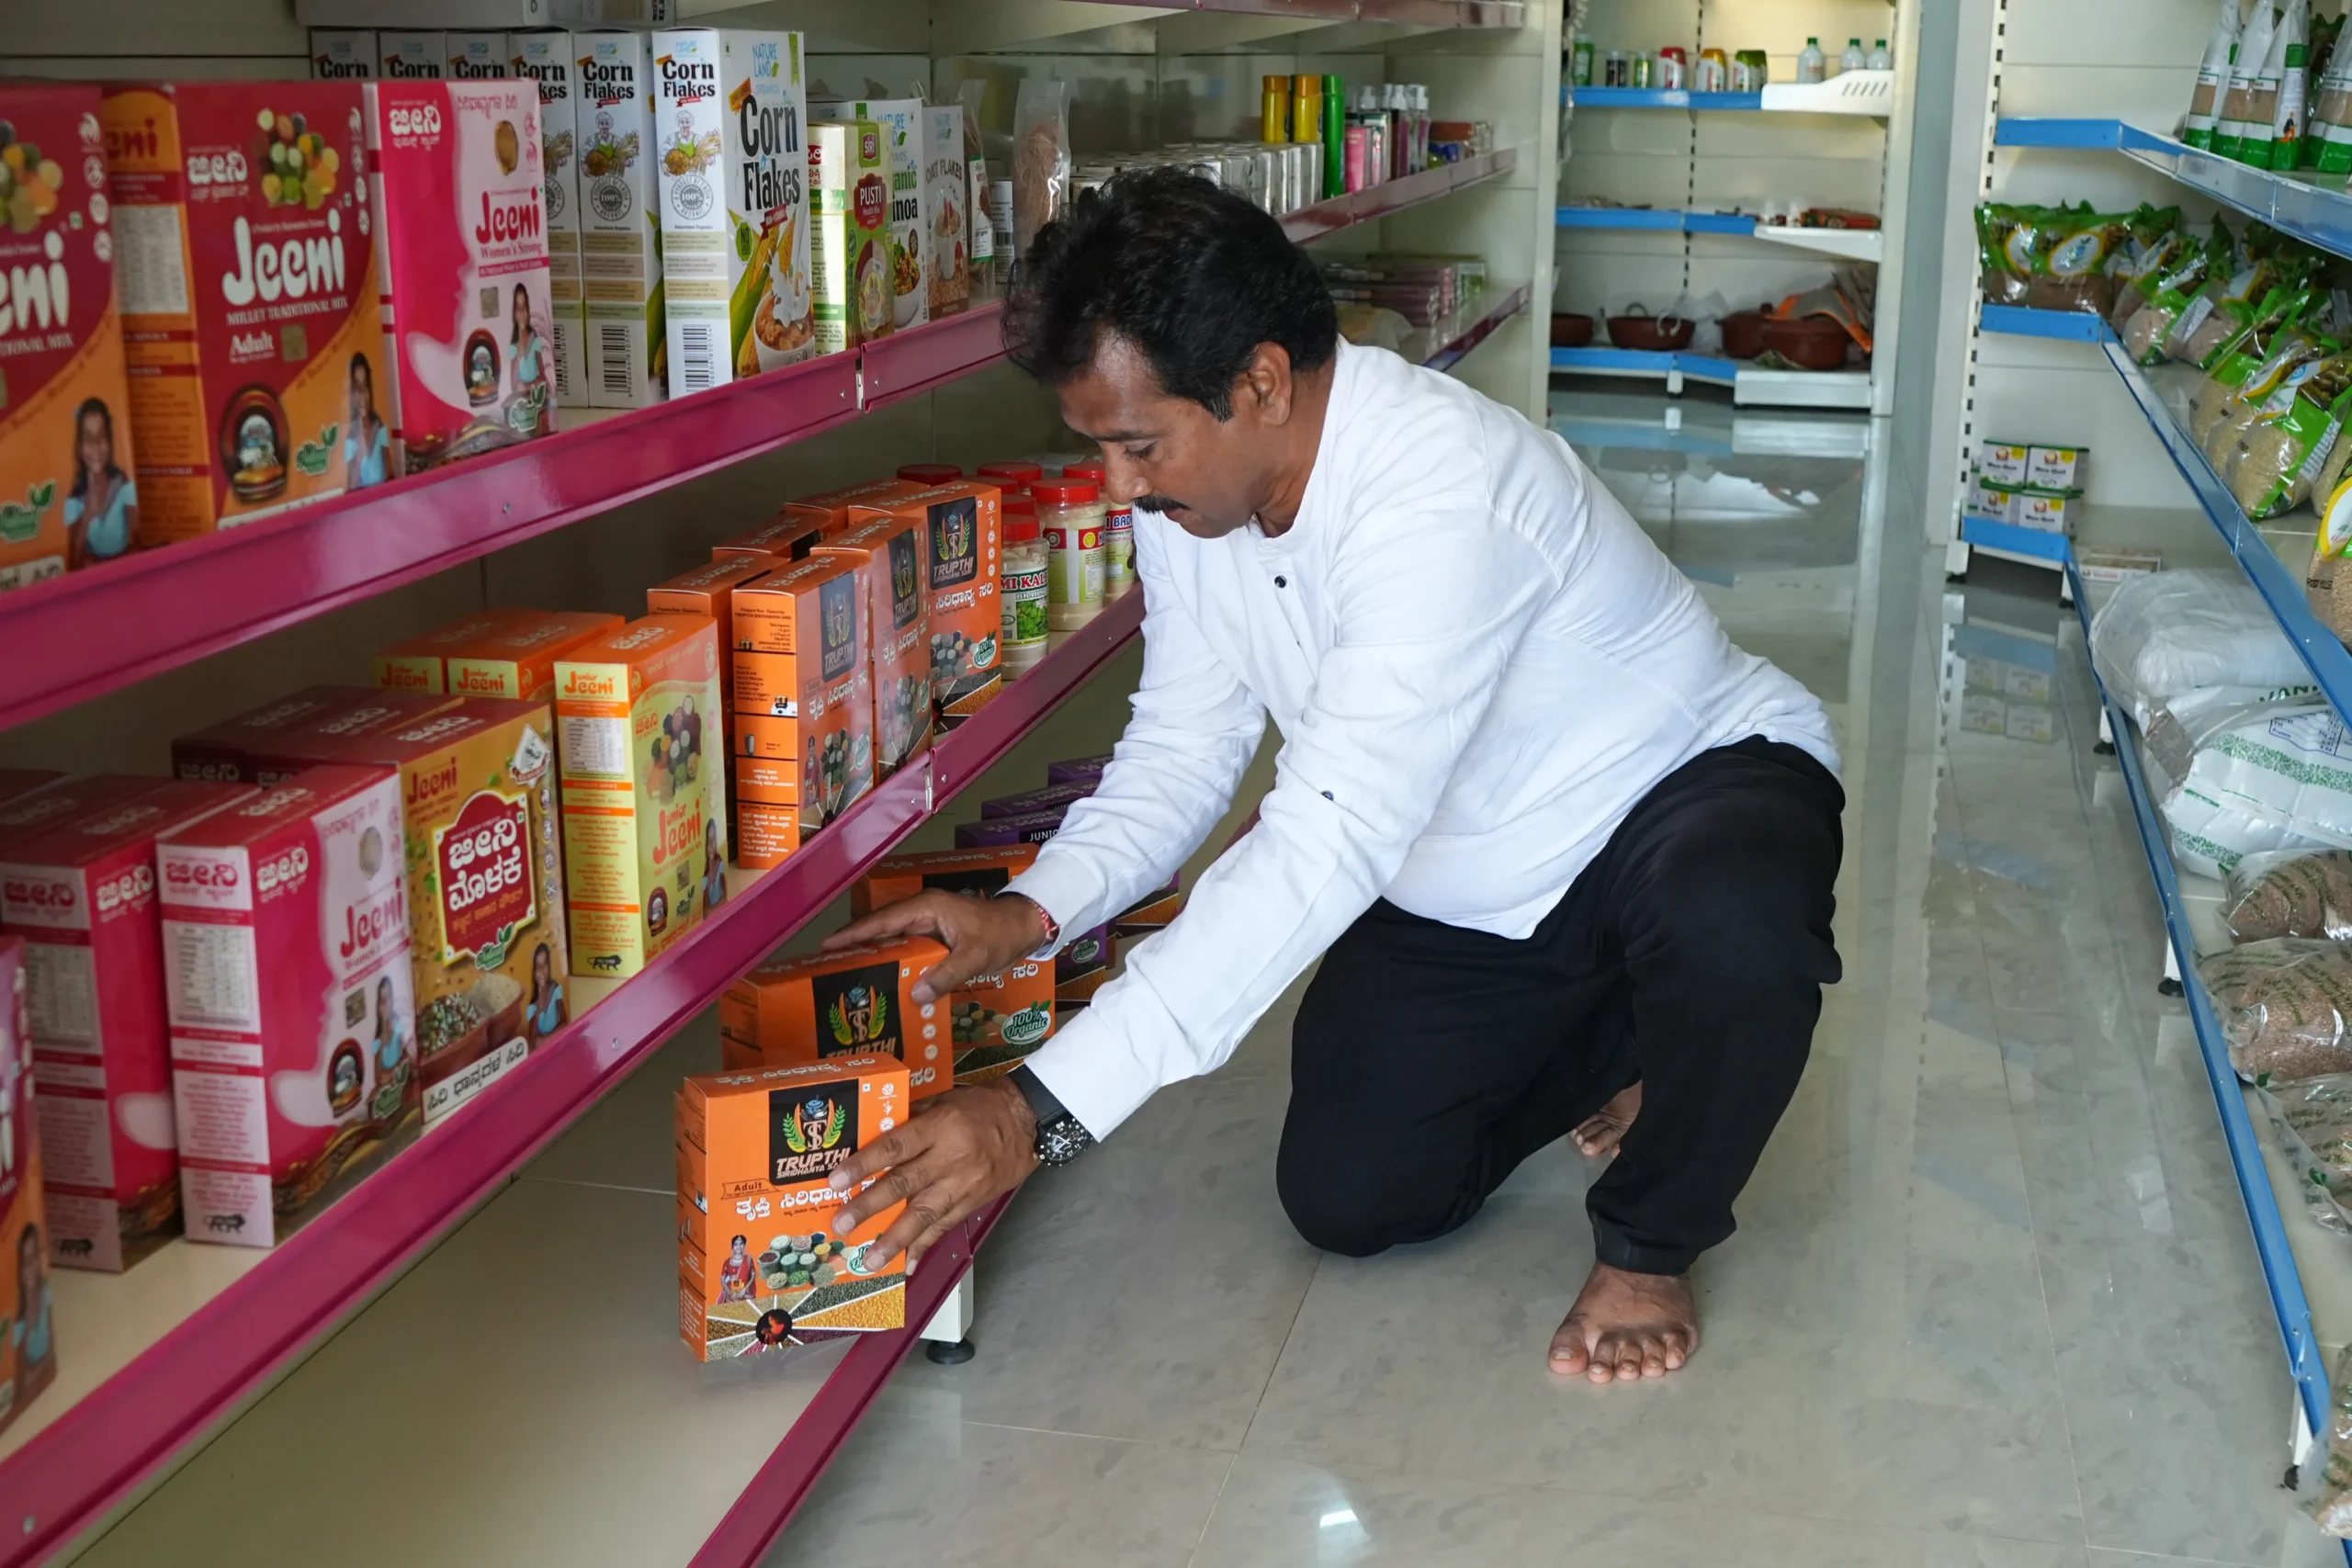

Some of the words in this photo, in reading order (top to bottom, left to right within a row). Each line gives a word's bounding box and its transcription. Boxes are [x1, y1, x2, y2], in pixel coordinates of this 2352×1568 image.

[752, 42, 778, 60] NATURE
[321, 60, 369, 79] Corn
[390, 60, 440, 79] Corn
[455, 60, 505, 79] Corn
[514, 61, 565, 81] Corn
[582, 61, 634, 82] Corn
[662, 59, 714, 80] Corn
[753, 60, 773, 78] LAND
[539, 83, 567, 99] kes
[584, 82, 635, 99] Flakes
[662, 81, 716, 98] Flakes
[389, 104, 442, 135] ಜೀನಿ
[741, 95, 798, 158] Corn
[107, 117, 158, 159] eni
[187, 150, 248, 185] ಜೀನಿ
[893, 164, 917, 191] anic
[926, 161, 939, 183] OAT
[939, 158, 962, 181] FLAKES
[681, 192, 704, 201] 100%
[743, 160, 800, 212] Flakes
[860, 186, 882, 206] PUSTI
[601, 193, 622, 203] 100%
[892, 194, 918, 221] inoa
[475, 186, 540, 244] Jeeni
[741, 228, 750, 244] NO
[222, 208, 345, 306] Jeeni
[481, 244, 517, 260] Women's
[518, 242, 543, 255] Strong
[0, 230, 70, 336] eni
[226, 309, 266, 327] MILLET
[267, 299, 331, 321] TRADITIONAL
[331, 296, 348, 309] MIX
[229, 329, 275, 355] Adult
[1113, 514, 1133, 529] BAD
[933, 556, 974, 579] TRUPTHI
[1021, 573, 1046, 589] KAL
[935, 587, 976, 610] ಸಿರಿಧಾನ್ಯ
[978, 582, 994, 598] ಸರಿ
[824, 641, 854, 667] TRUPTHI
[380, 664, 429, 687] Jeeni
[457, 667, 505, 691] Jeeni
[564, 671, 615, 694] Jeeni
[407, 755, 458, 806] Jeeni
[652, 797, 702, 864] Jeeni
[1029, 829, 1058, 842] JUNIO
[448, 818, 517, 870] ಜೀನಿ
[165, 861, 239, 887] ಜೀನಿ
[255, 846, 310, 892] ಜೀನಿ
[447, 845, 523, 911] ಮೊಳಕೆ
[96, 865, 154, 911] ಜೀನಿ
[340, 875, 404, 958] Jeeni
[1012, 963, 1039, 979] ಸರಿ
[1003, 1018, 1048, 1039] Organic
[1013, 1007, 1042, 1027] 100%
[910, 1066, 936, 1088] ಸರಿ
[776, 1147, 851, 1173] TRUPTHI
[776, 1166, 825, 1179] SIRIDHANYA
[734, 1181, 762, 1191] Adult
[736, 1196, 771, 1221] ತೃಪ್ತಿ
